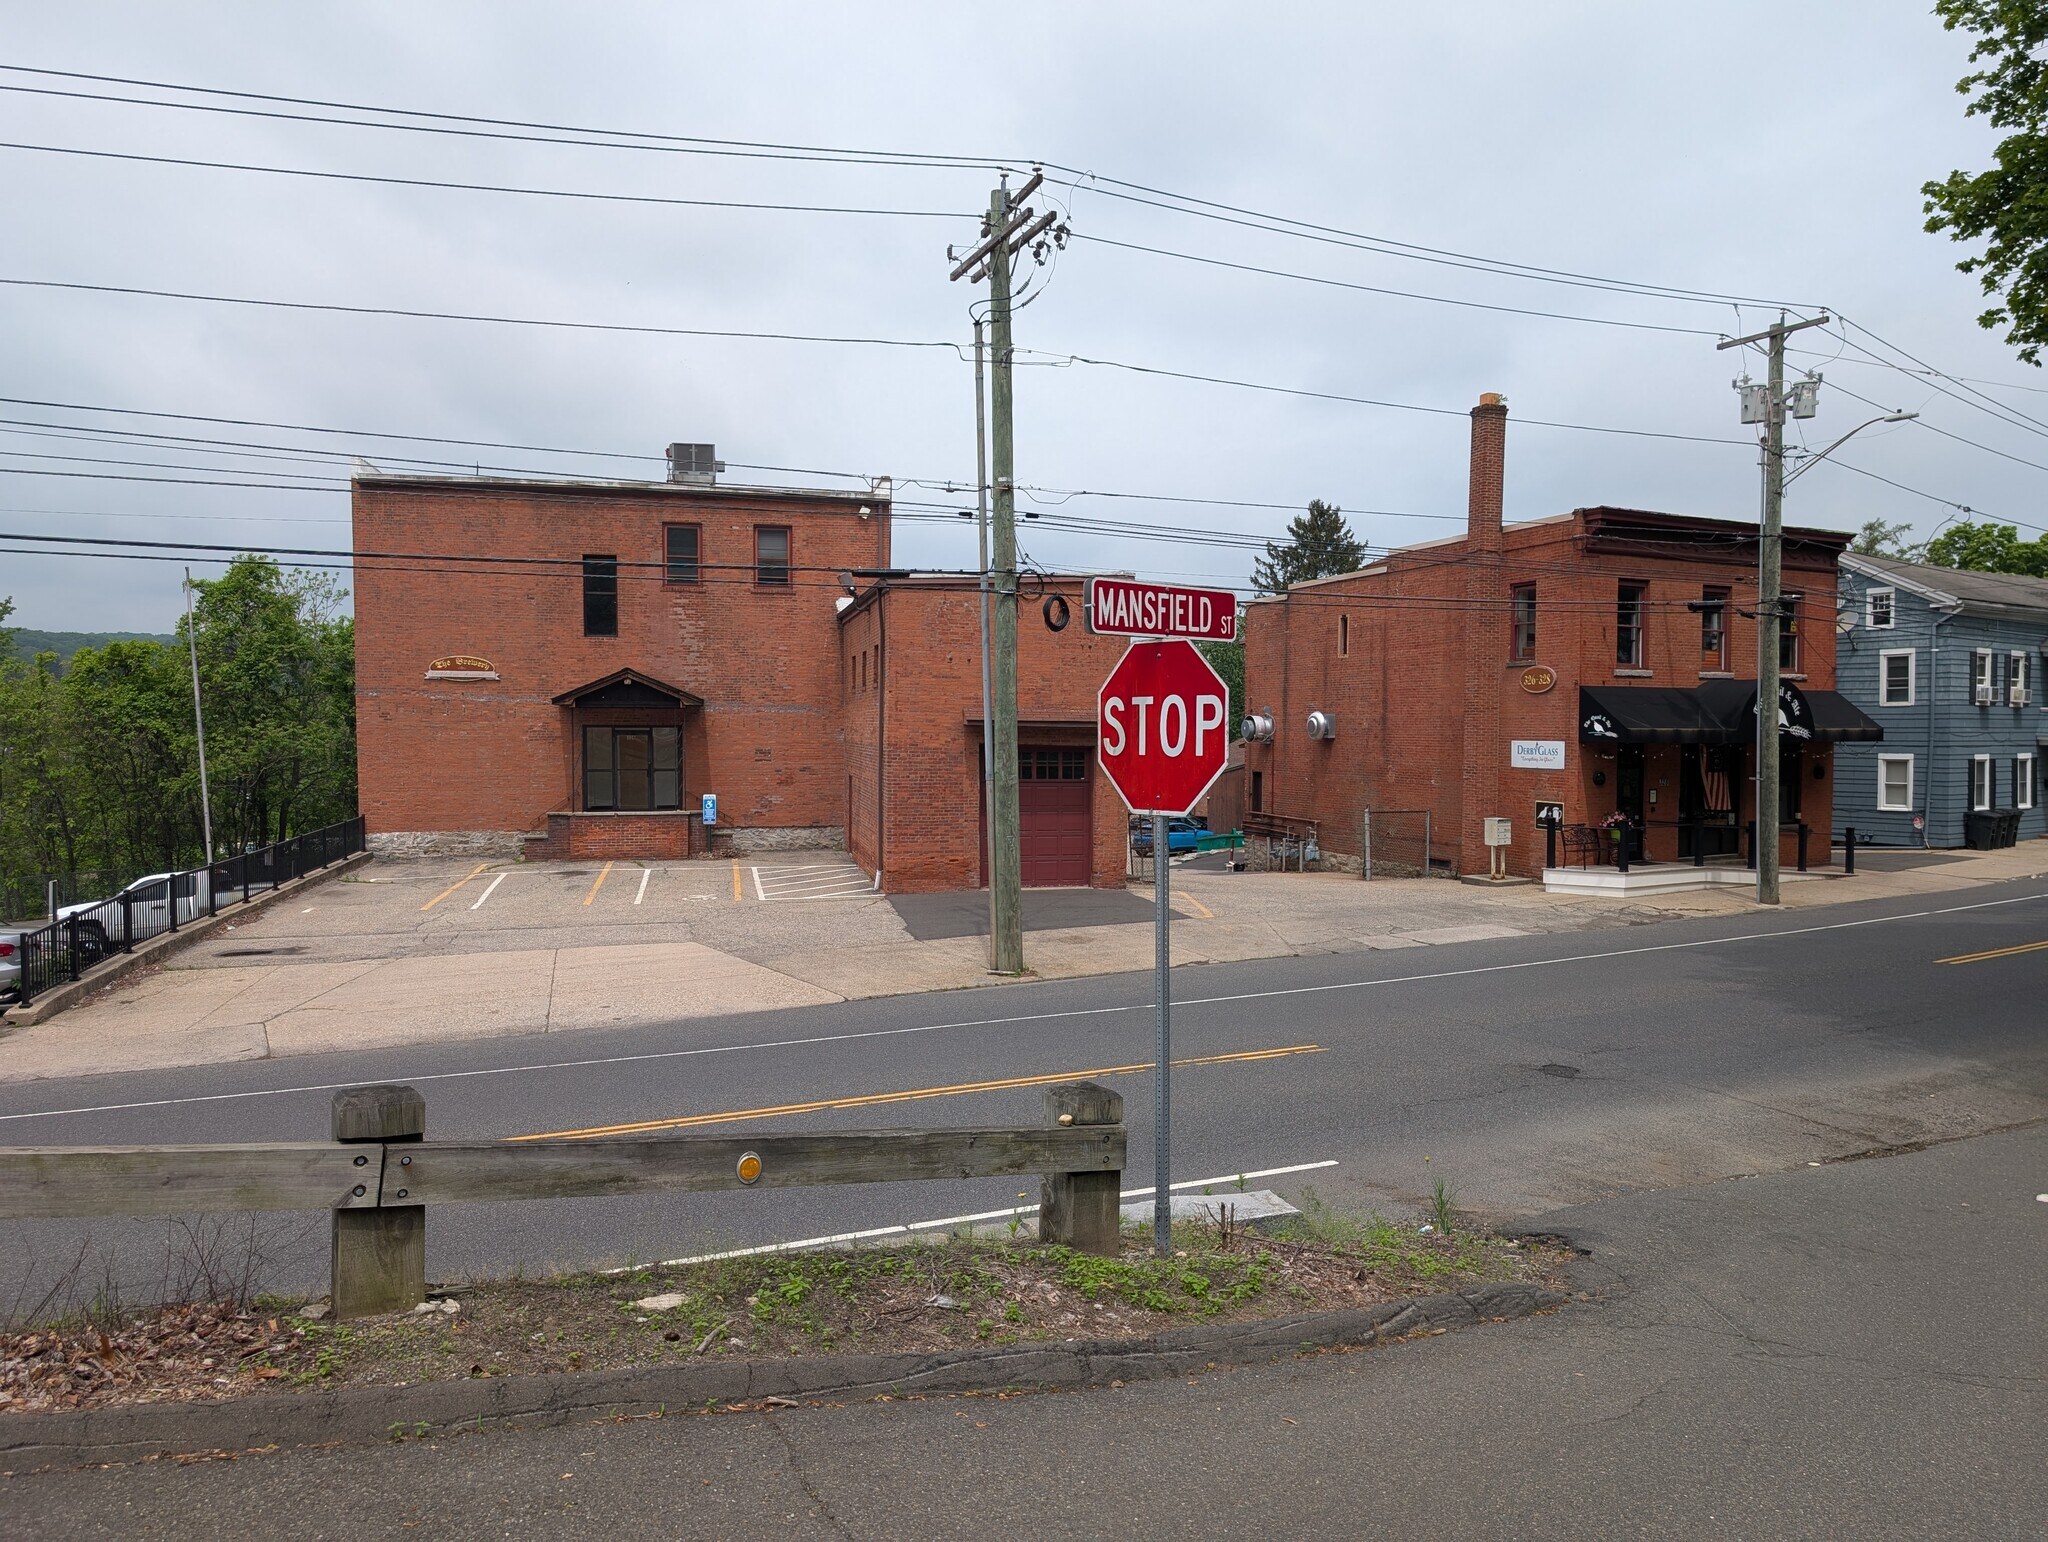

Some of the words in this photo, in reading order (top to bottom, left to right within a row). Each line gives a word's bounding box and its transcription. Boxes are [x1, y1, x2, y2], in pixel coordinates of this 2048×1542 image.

[1098, 586, 1212, 633] MANSFIELD
[1220, 615, 1232, 635] ST
[435, 660, 451, 669] The
[455, 657, 490, 670] Brewery
[1523, 673, 1551, 685] 326-328
[1103, 694, 1223, 758] STOP
